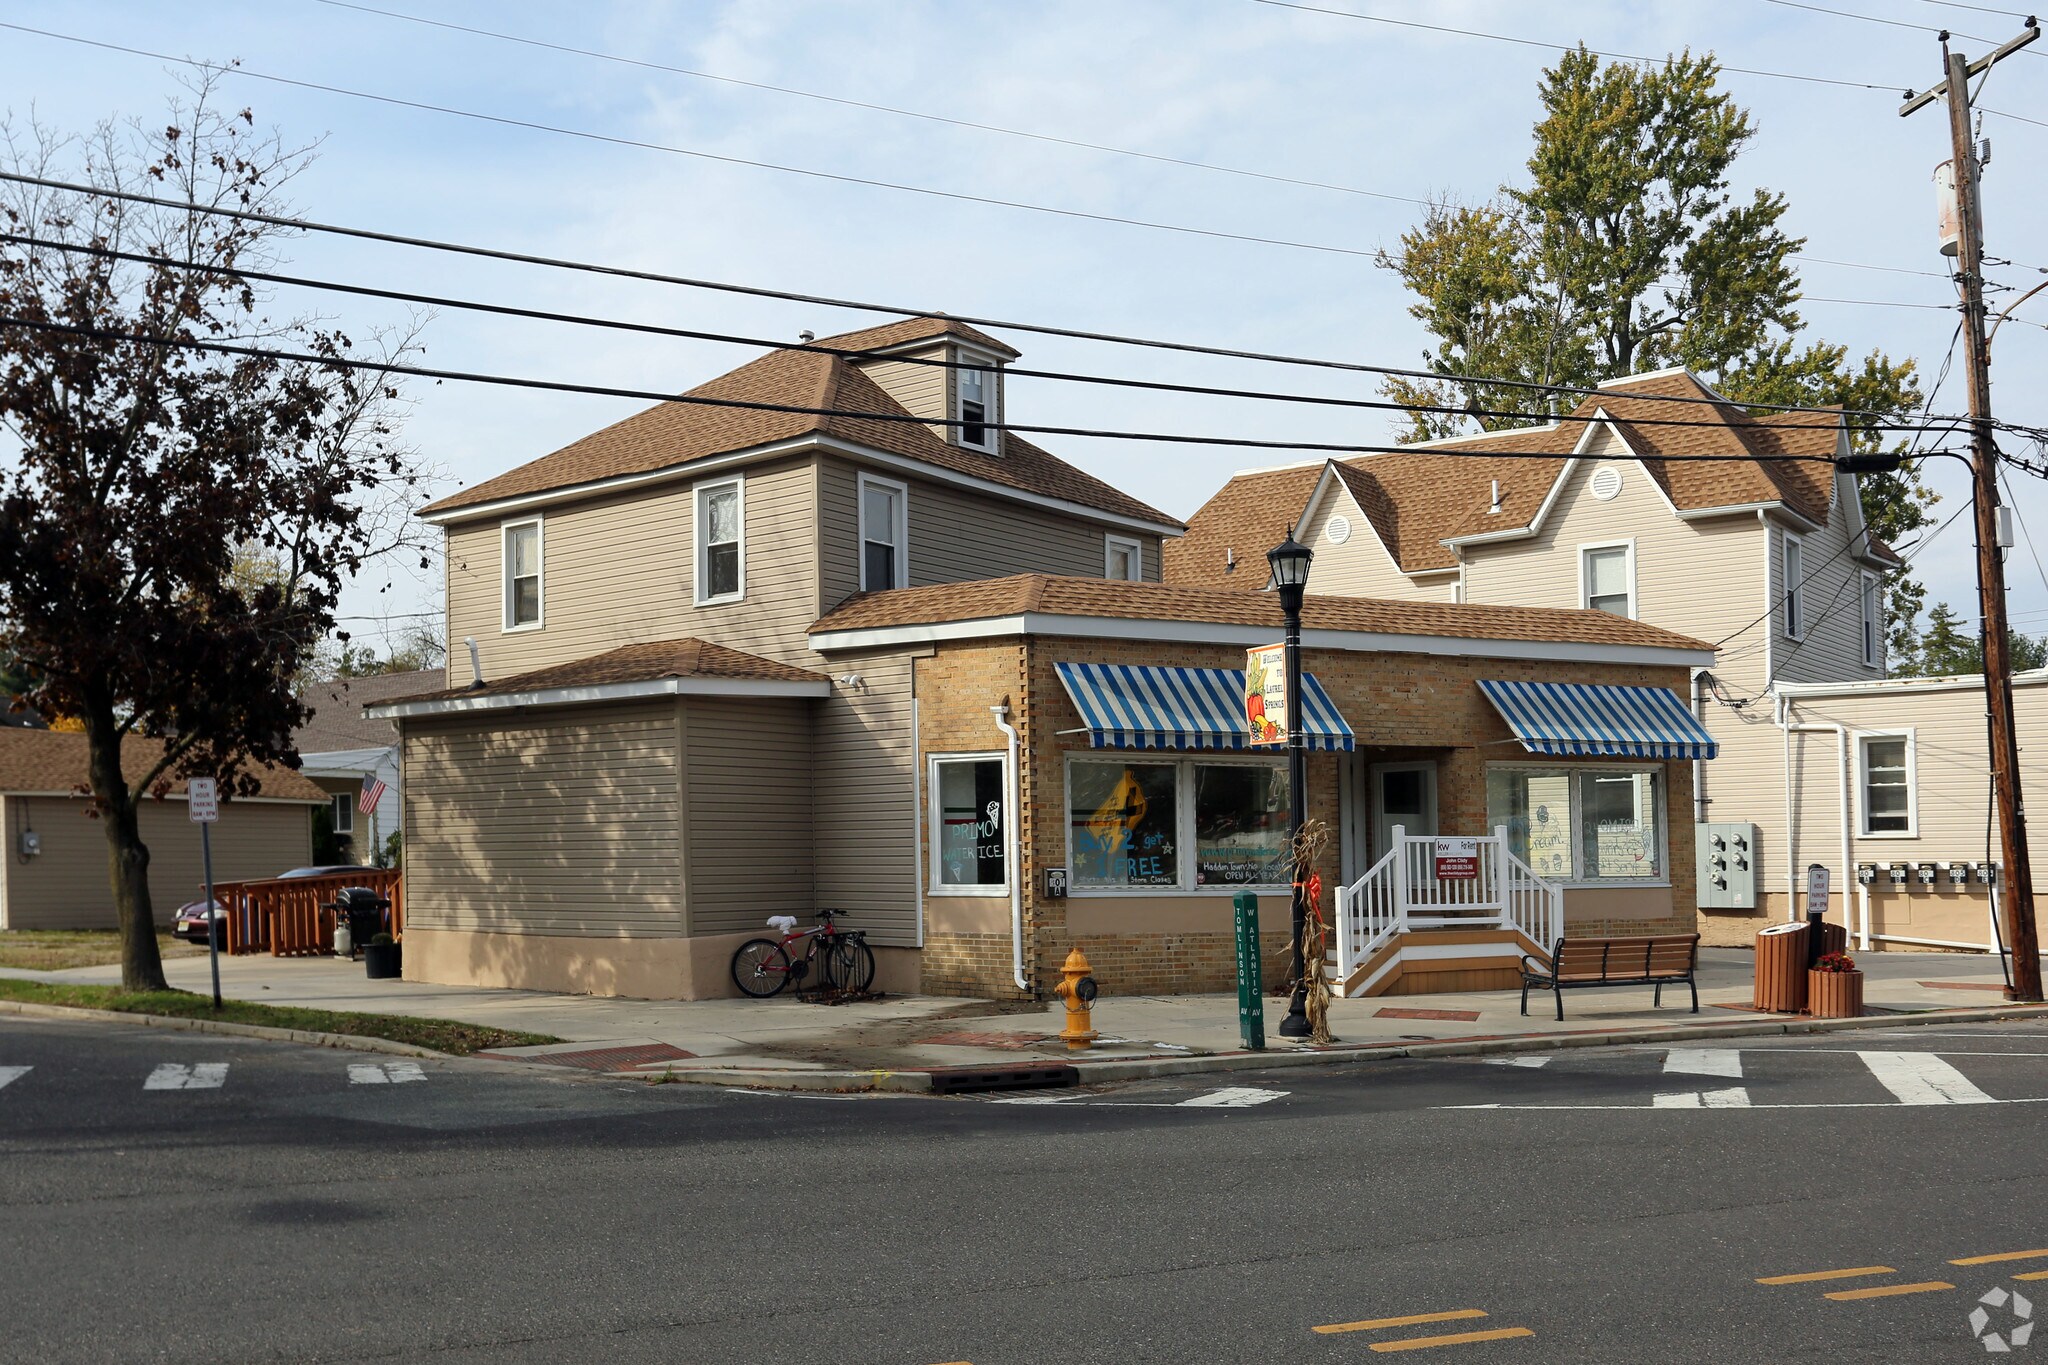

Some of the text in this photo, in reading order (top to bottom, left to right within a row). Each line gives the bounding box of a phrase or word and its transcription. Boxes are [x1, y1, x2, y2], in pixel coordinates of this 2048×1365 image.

[1265, 700, 1284, 709] SPRINGS
[952, 820, 994, 839] PRIMO
[1079, 831, 1113, 857] Buy
[1143, 832, 1164, 849] get
[1437, 841, 1449, 851] kw
[1467, 841, 1476, 849] Rent
[943, 845, 1004, 861] WATER ICE
[1115, 856, 1163, 876] FREE
[1225, 871, 1245, 880] OPEN
[1245, 871, 1258, 879] ALL
[1055, 886, 1060, 895] A
[1236, 908, 1247, 1015] TOMLINSON AV
[1247, 909, 1260, 1016] W ATLANTIC AV
